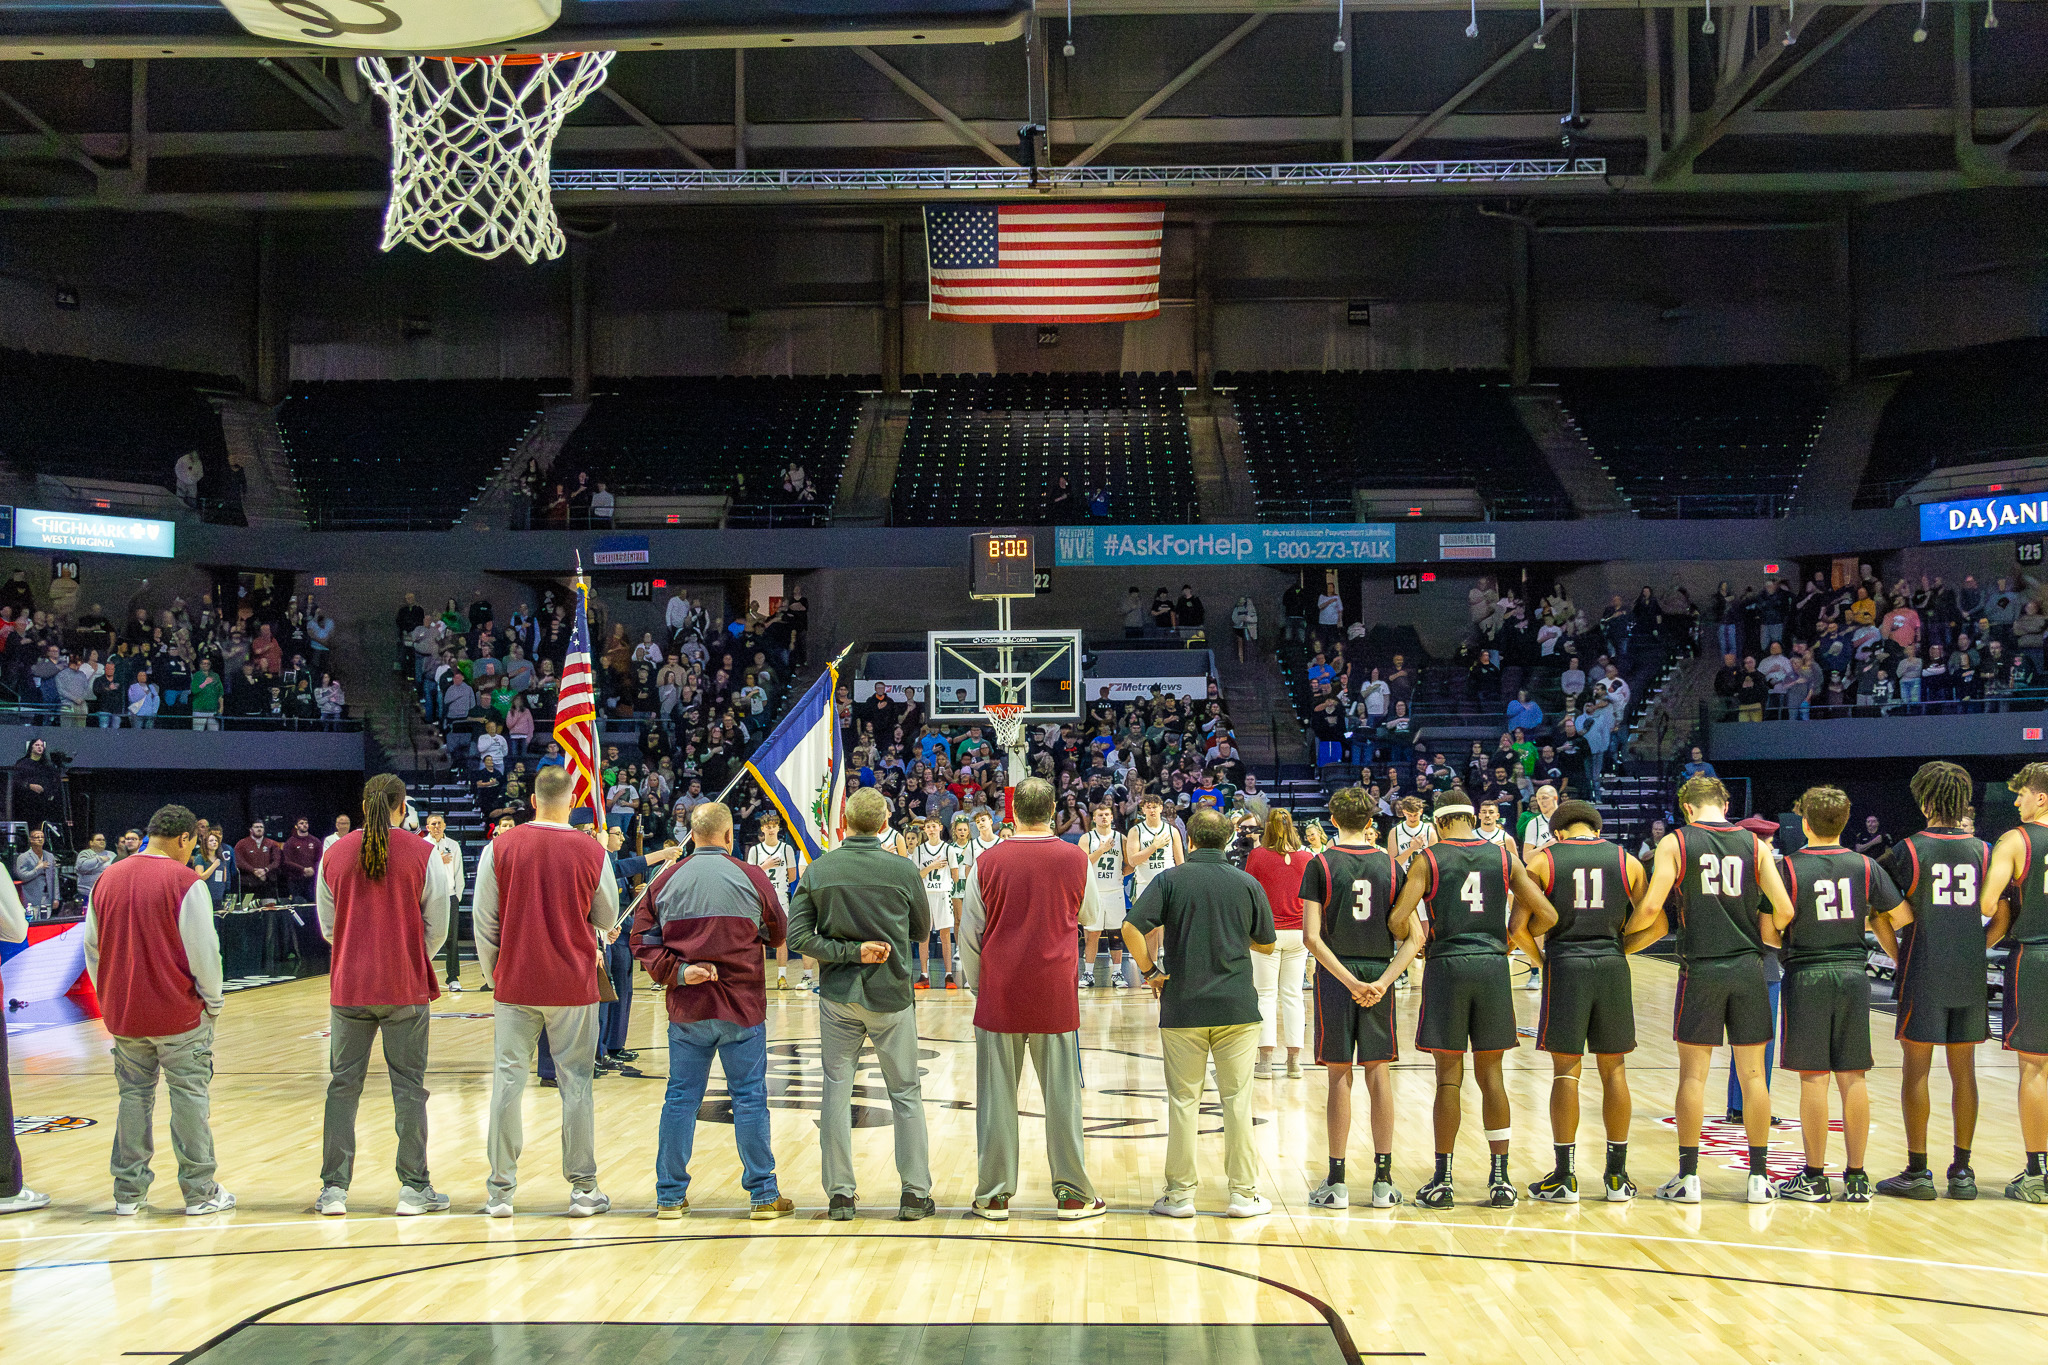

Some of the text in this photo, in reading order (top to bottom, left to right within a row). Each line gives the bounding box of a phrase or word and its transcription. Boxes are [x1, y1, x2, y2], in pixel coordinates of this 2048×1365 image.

[1949, 500, 2048, 532] DASANI
[41, 518, 127, 538] HIGHMARK
[42, 534, 115, 548] WEST VIRGINIA
[989, 540, 1027, 557] 8:00
[1059, 538, 1085, 559] WV
[1103, 532, 1253, 560] #AskForHelp
[1263, 541, 1390, 559] 1-800-273-TALK
[2018, 543, 2042, 560] 125
[630, 582, 649, 596] 121
[1034, 573, 1050, 588] 22
[1396, 574, 1417, 589] 123
[1122, 682, 1182, 692] Metroews
[1097, 857, 1115, 871] 42
[1097, 871, 1114, 879] EAST
[1699, 853, 1744, 897] 20
[1931, 863, 1976, 906] 23
[1460, 871, 1485, 912] 4
[1572, 868, 1604, 909] 11
[1352, 879, 1372, 920] 3
[1813, 877, 1855, 921] 21
